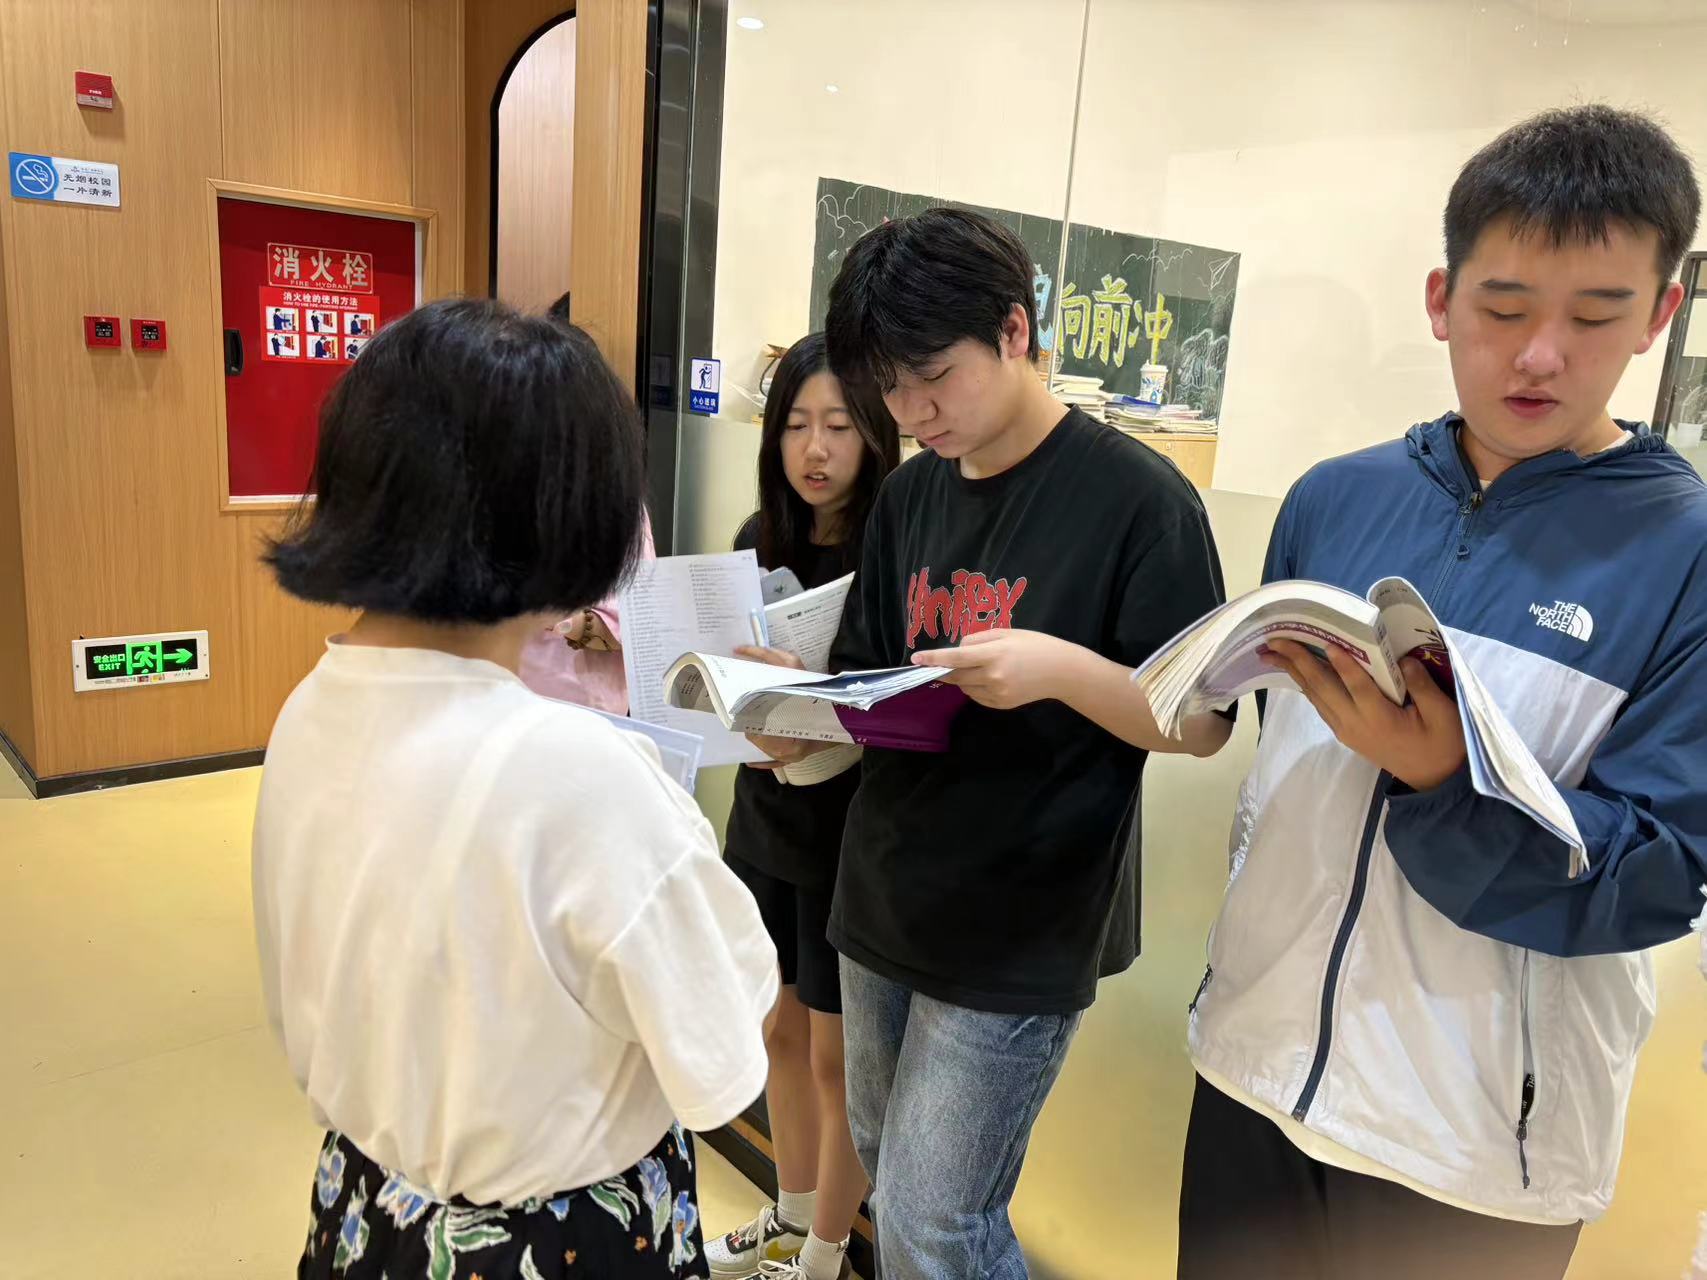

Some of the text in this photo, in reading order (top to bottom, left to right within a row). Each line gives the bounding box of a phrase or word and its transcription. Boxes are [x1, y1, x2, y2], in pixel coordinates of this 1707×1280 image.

[273, 247, 368, 286] 消火栓
[315, 281, 353, 290] HYDRANT
[283, 291, 358, 306] 消火栓的使用方法
[1528, 602, 1574, 625] NORTH
[1554, 601, 1577, 613] THE
[1536, 617, 1567, 632] FACE
[93, 653, 125, 664] 安全出口
[98, 662, 120, 671] EXIT
